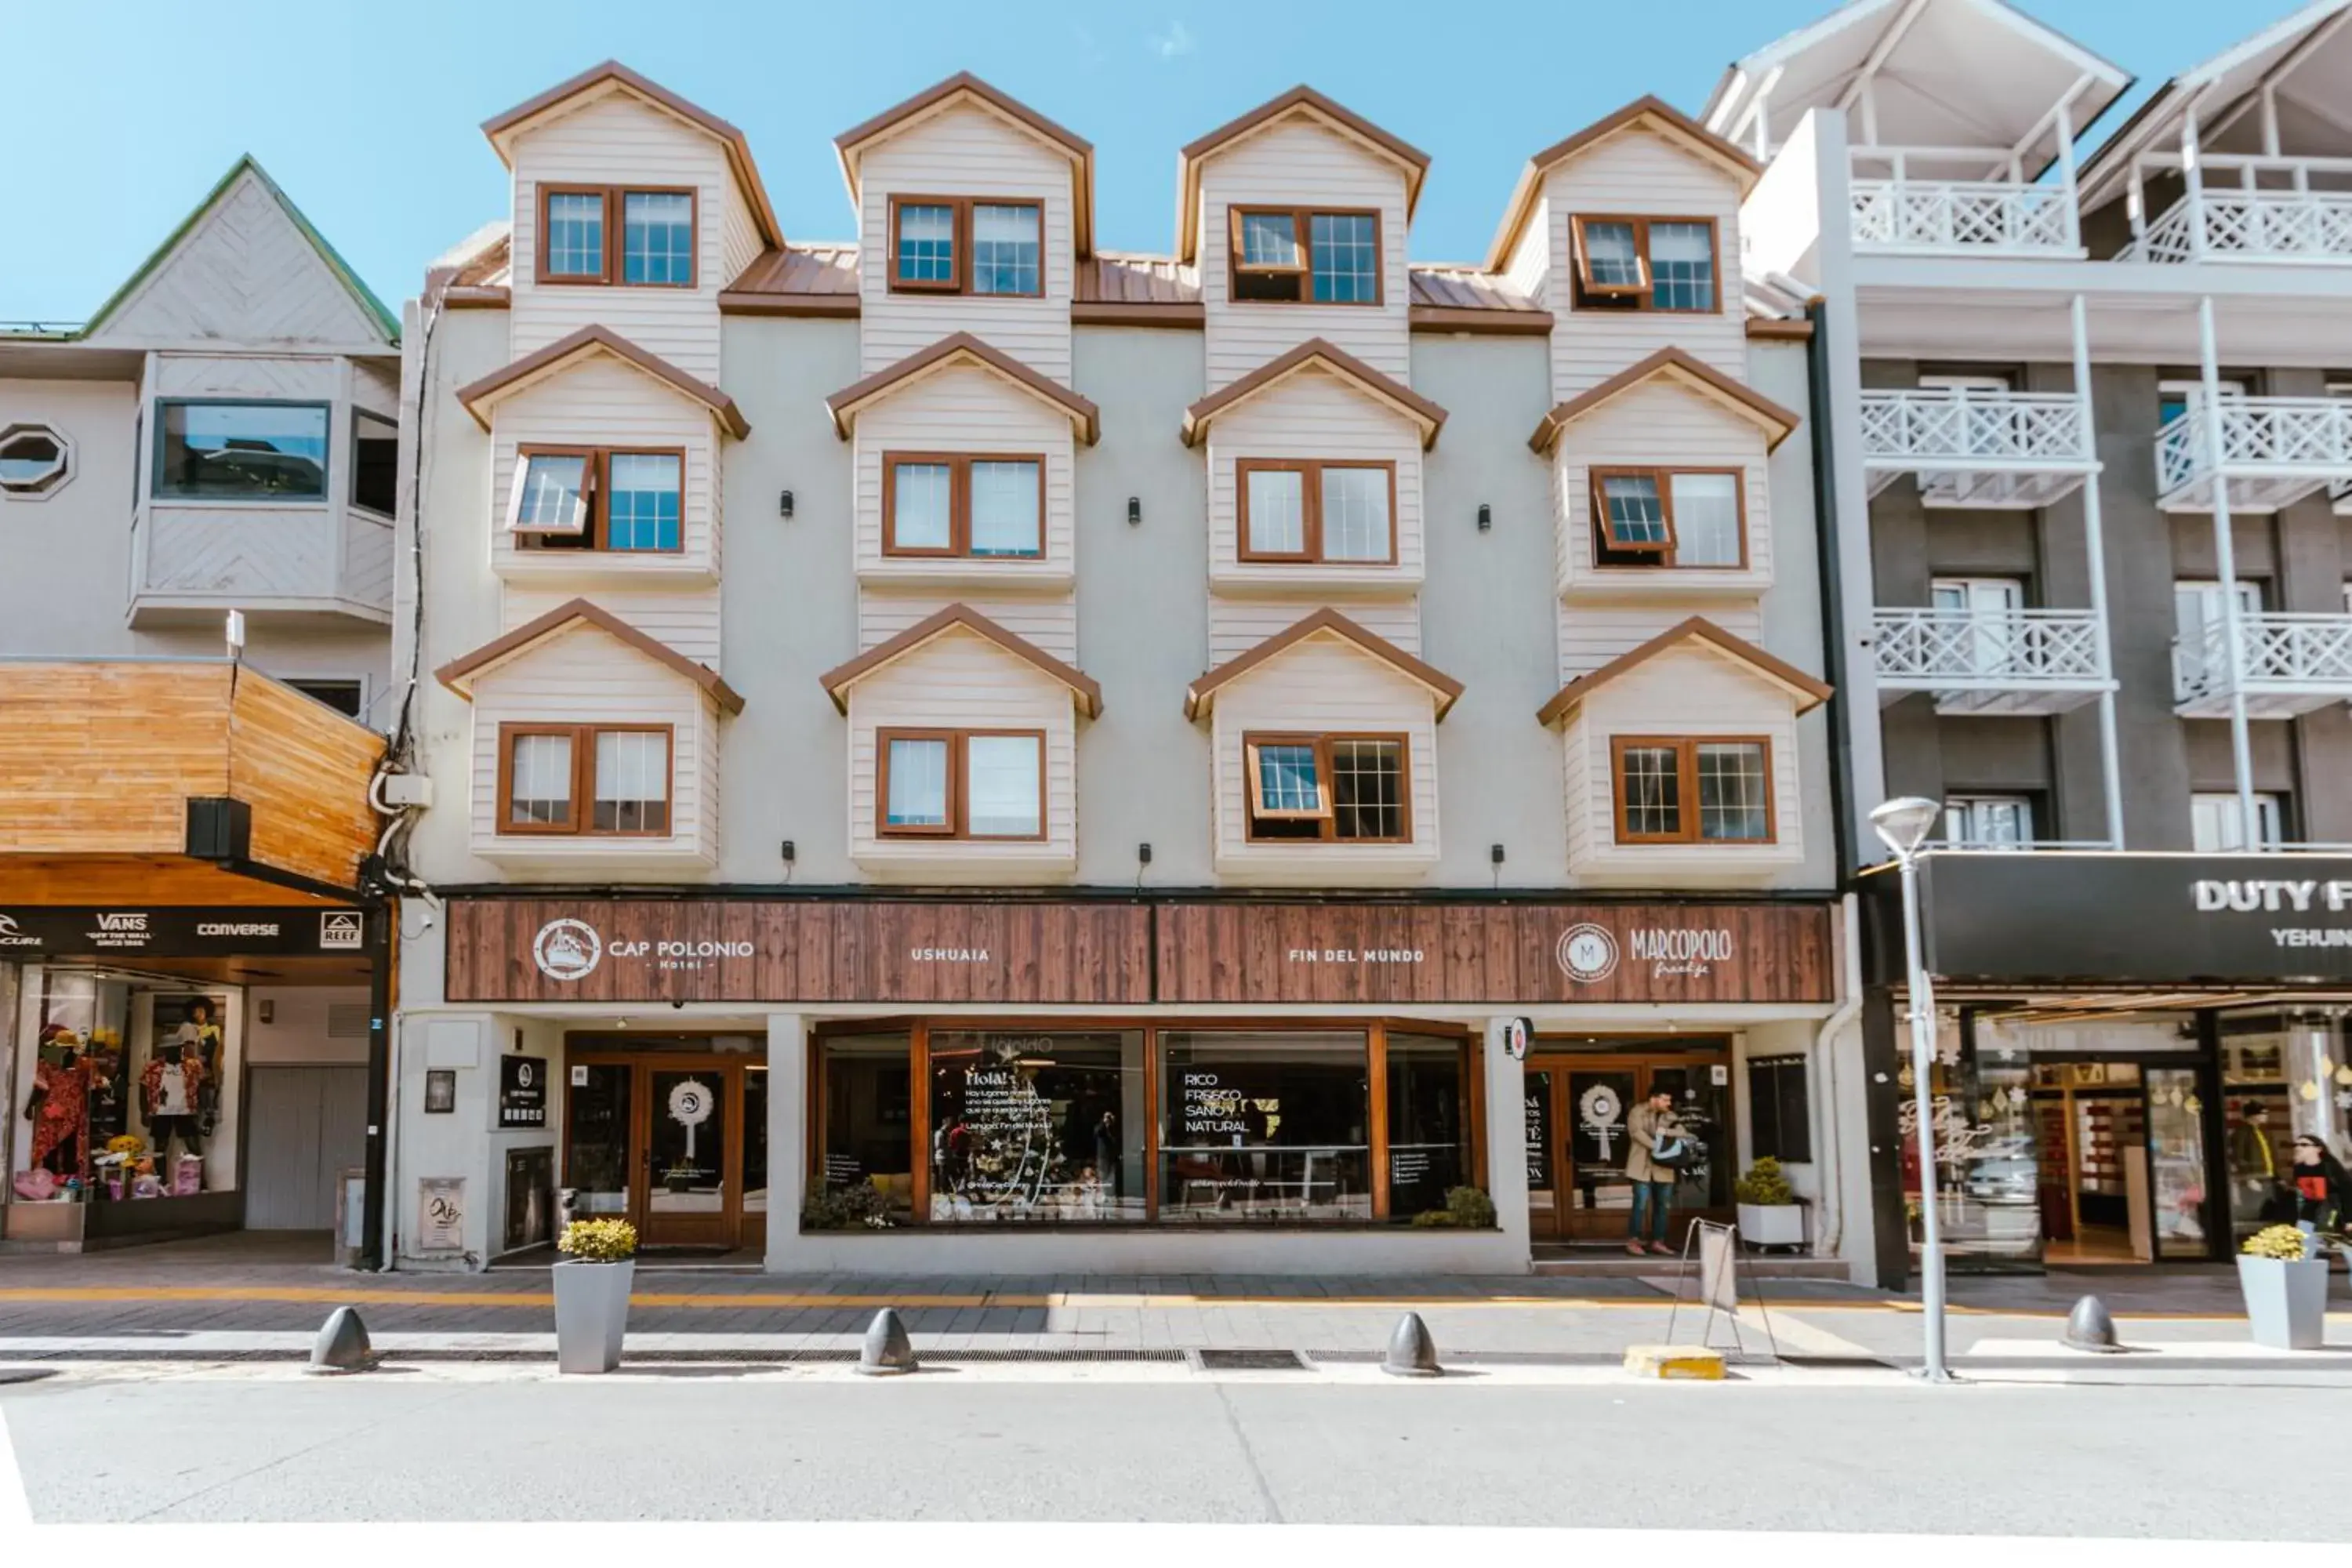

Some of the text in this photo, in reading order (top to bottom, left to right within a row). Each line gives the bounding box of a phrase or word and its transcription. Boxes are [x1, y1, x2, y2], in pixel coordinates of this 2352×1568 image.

[2194, 880, 2318, 911] DUTY
[96, 913, 148, 931] VANS
[197, 924, 279, 936] CONVERSE
[325, 931, 358, 941] REEF
[608, 941, 754, 957] CAP POLONIO
[1631, 927, 1732, 961] MARCOPOLO
[911, 947, 989, 961] USHUAIA
[1288, 949, 1425, 963] FIN DEL MUNDO
[1581, 944, 1594, 964] M
[1185, 1074, 1218, 1086] RICO
[1185, 1089, 1242, 1102] FRESCO
[1185, 1105, 1237, 1117] SANO Y
[1185, 1120, 1250, 1132] NATURAL
